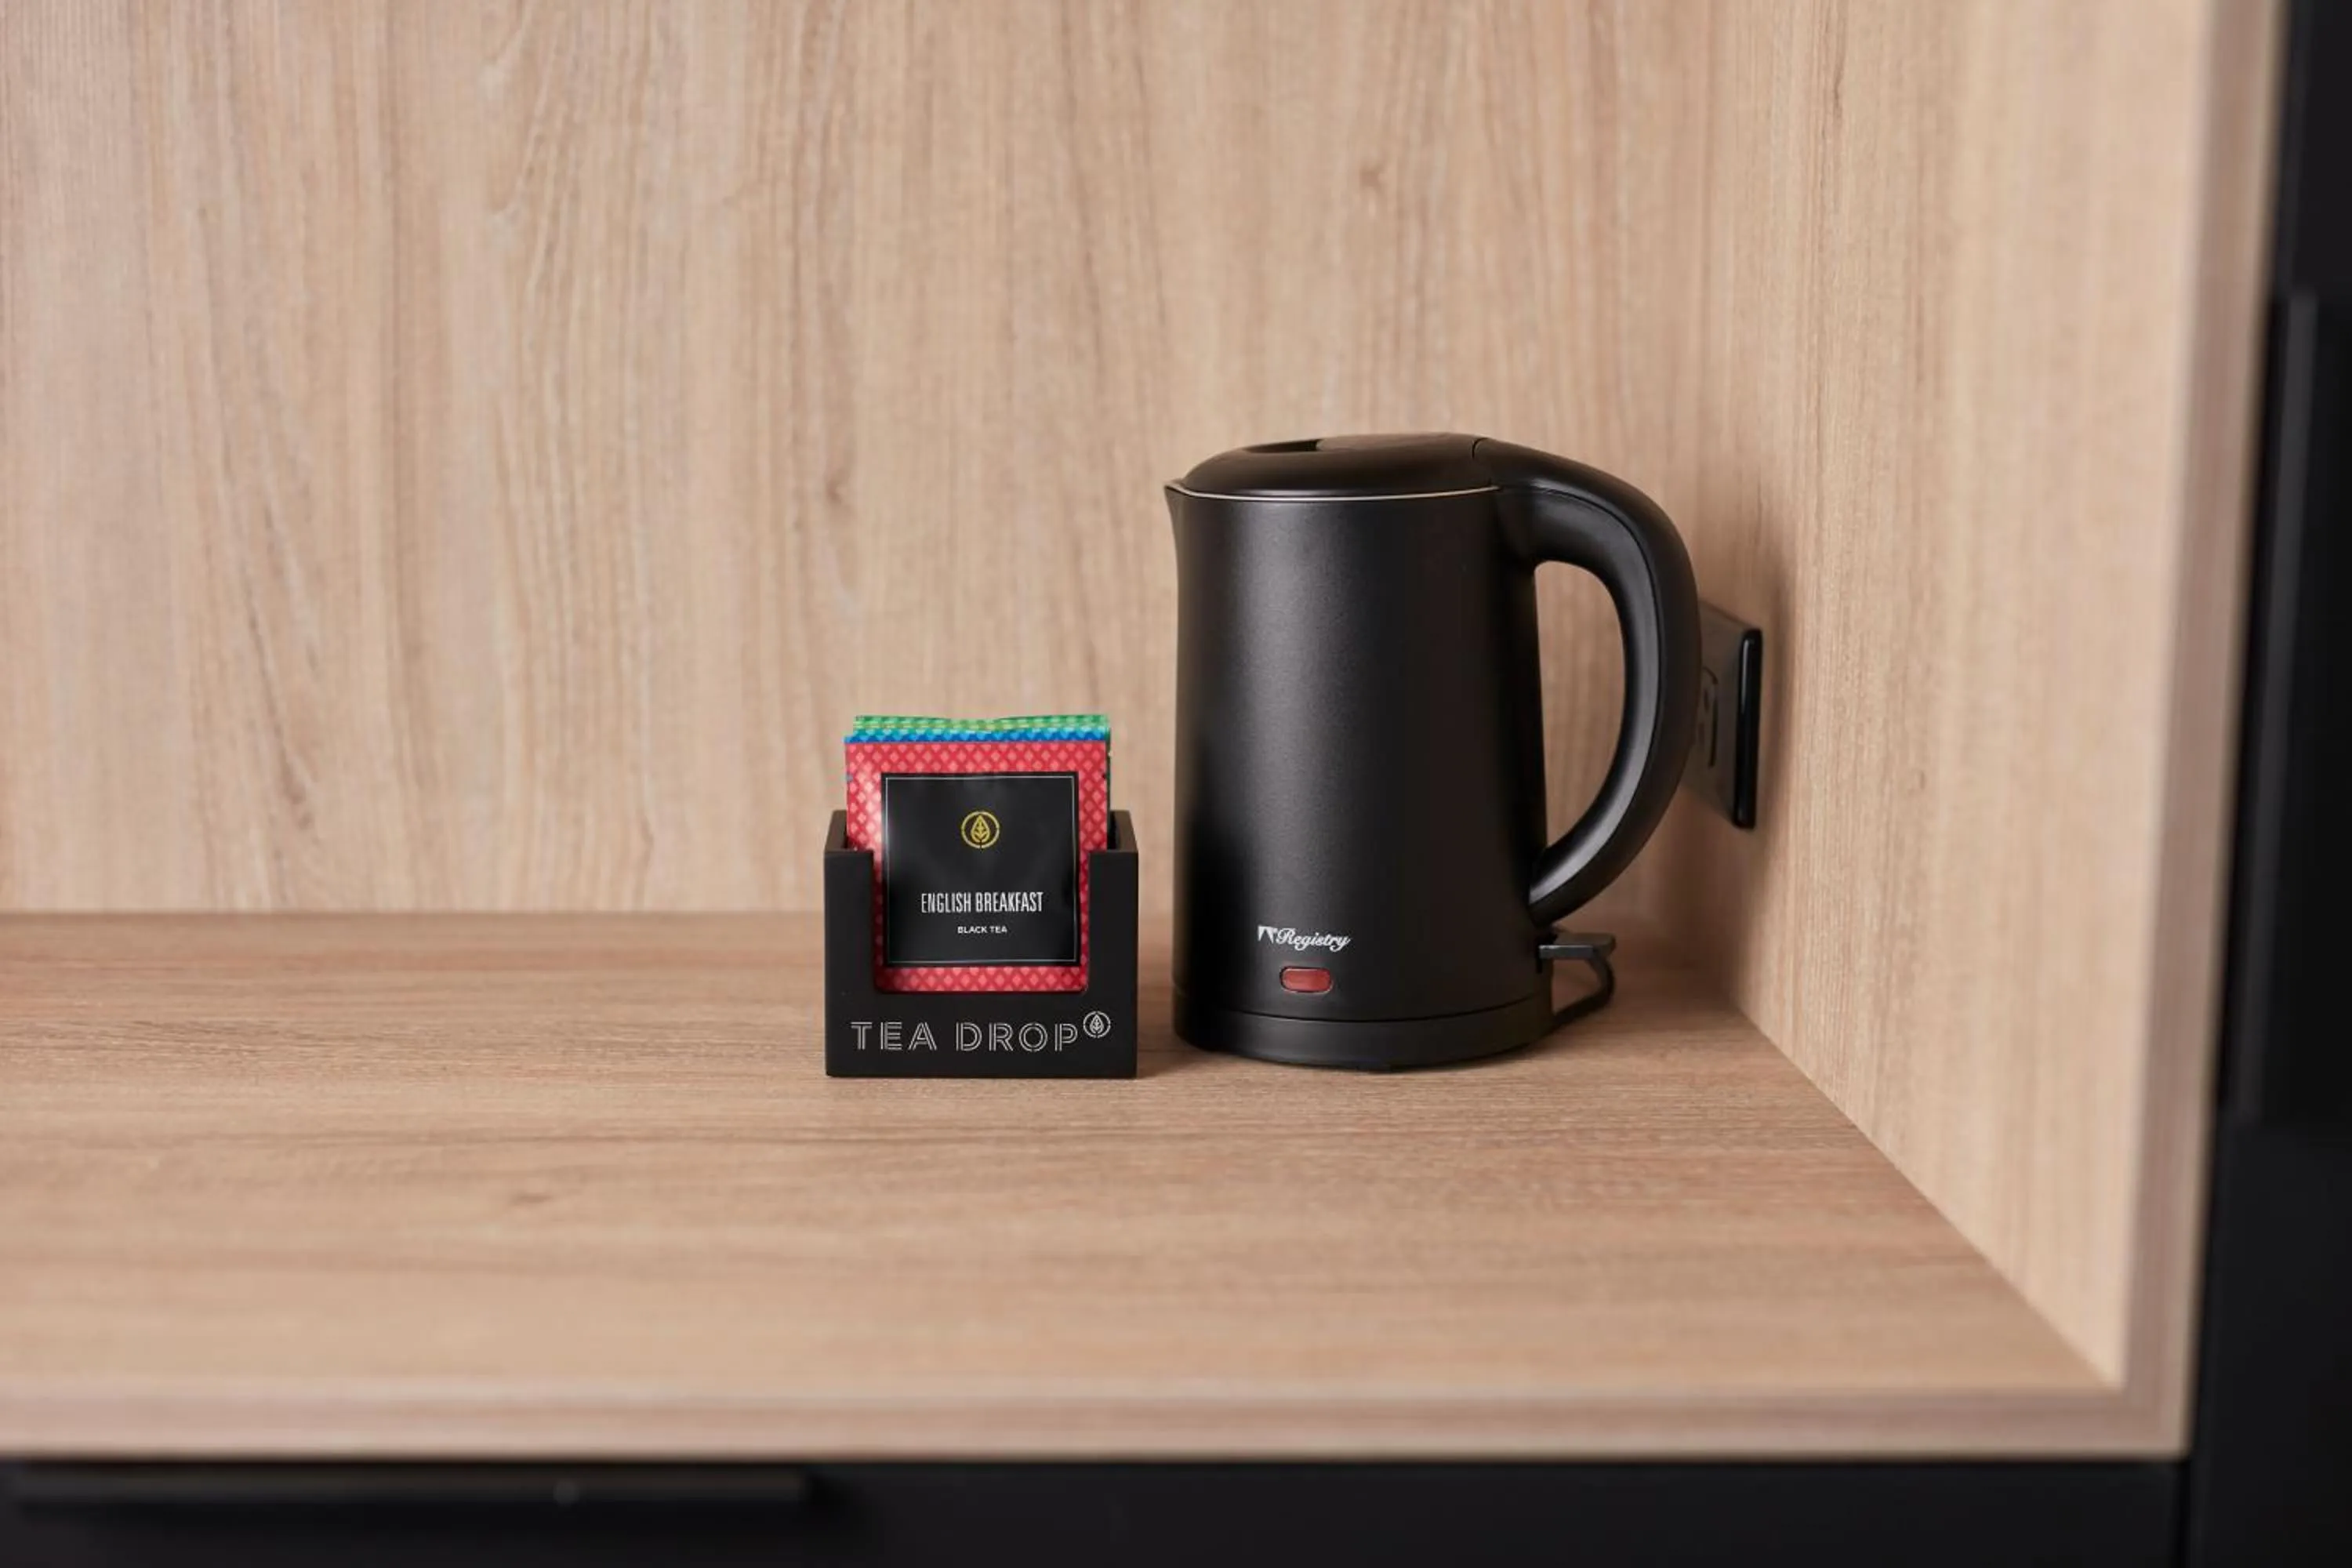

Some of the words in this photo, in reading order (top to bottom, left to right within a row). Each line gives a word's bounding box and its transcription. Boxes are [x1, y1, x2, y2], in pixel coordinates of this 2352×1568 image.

[920, 892, 972, 913] ENGLISH
[975, 891, 1044, 913] BREAKFAST
[956, 925, 987, 935] BLACK
[989, 925, 1007, 934] TEA
[1276, 927, 1352, 953] Registry
[851, 1021, 938, 1051] TEA
[955, 1022, 1079, 1053] DROP
